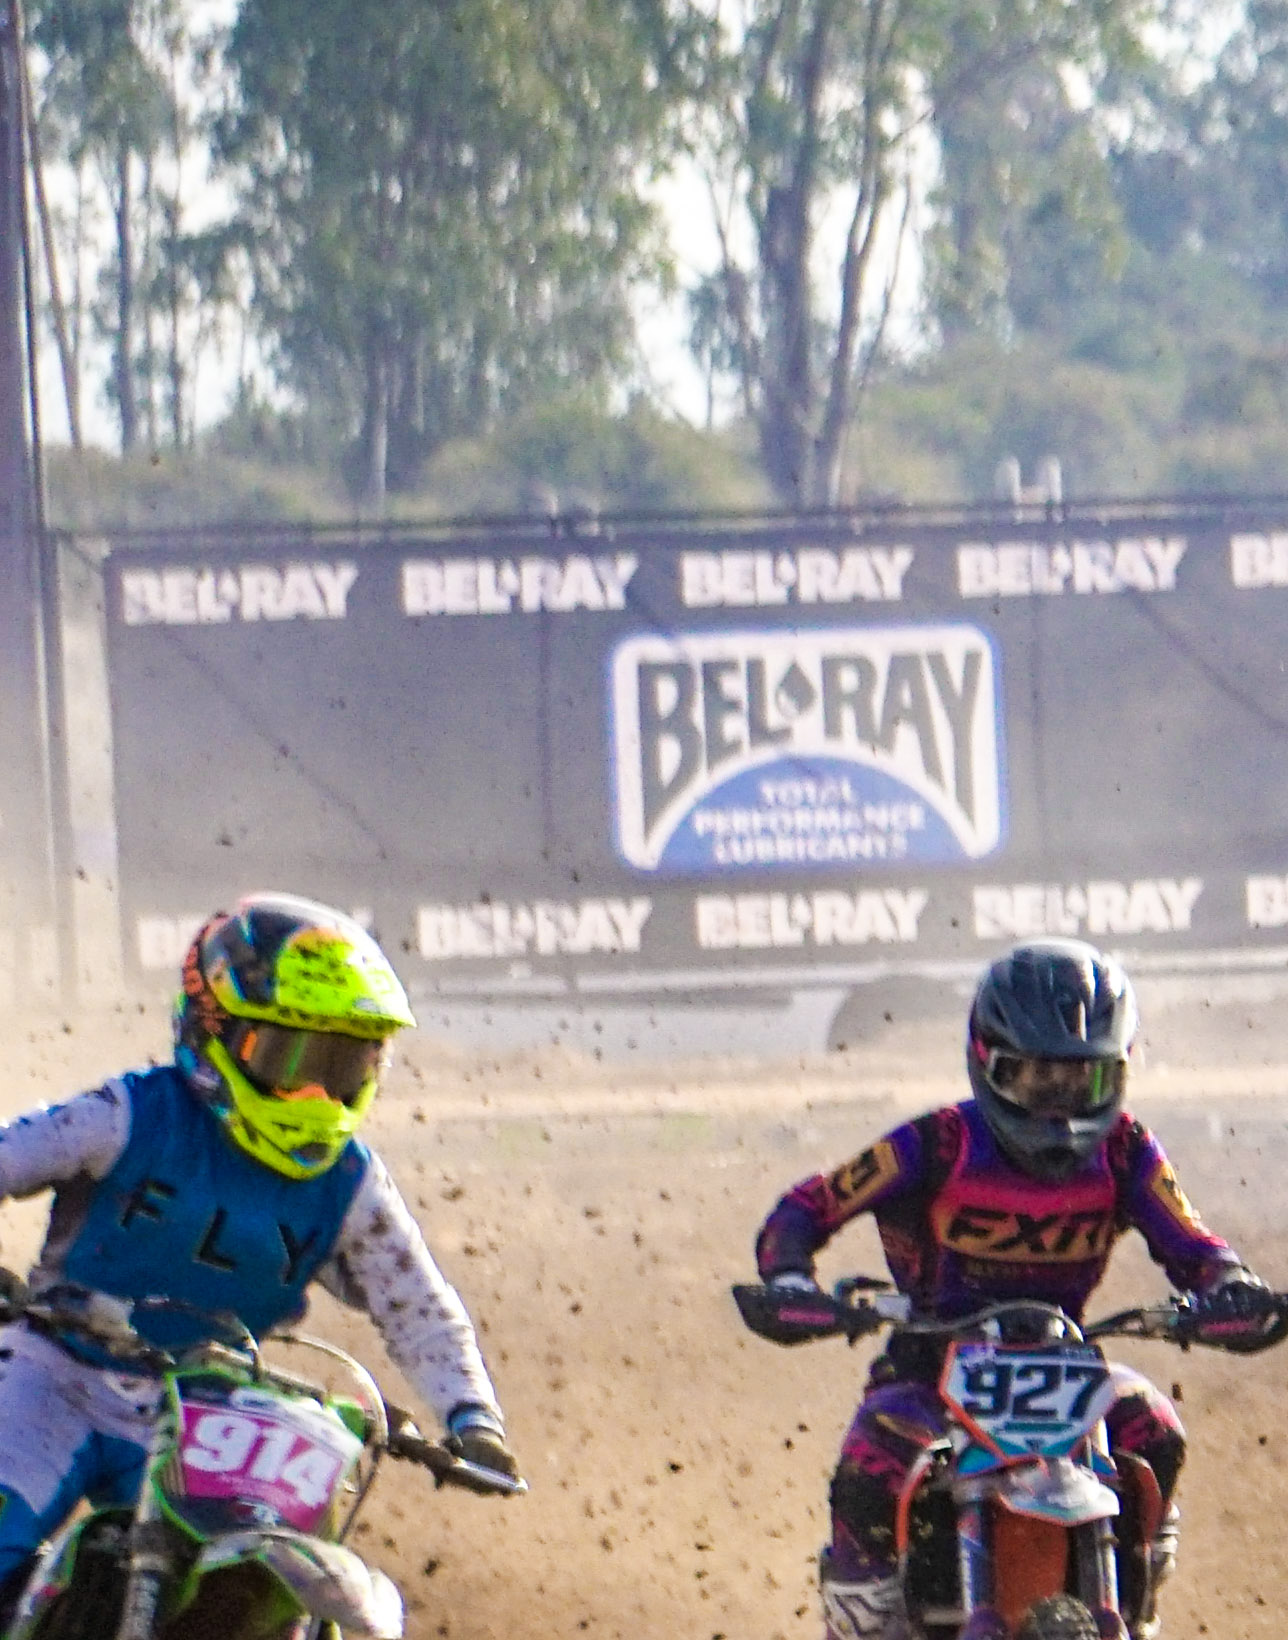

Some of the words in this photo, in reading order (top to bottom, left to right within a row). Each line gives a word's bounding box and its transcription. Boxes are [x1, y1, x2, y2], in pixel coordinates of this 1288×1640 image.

[761, 778, 852, 805] TOTAL
[715, 834, 908, 864] LUBRICANTS
[119, 1178, 326, 1288] FLY
[964, 1360, 1110, 1420] 927
[183, 1411, 337, 1508] 914
